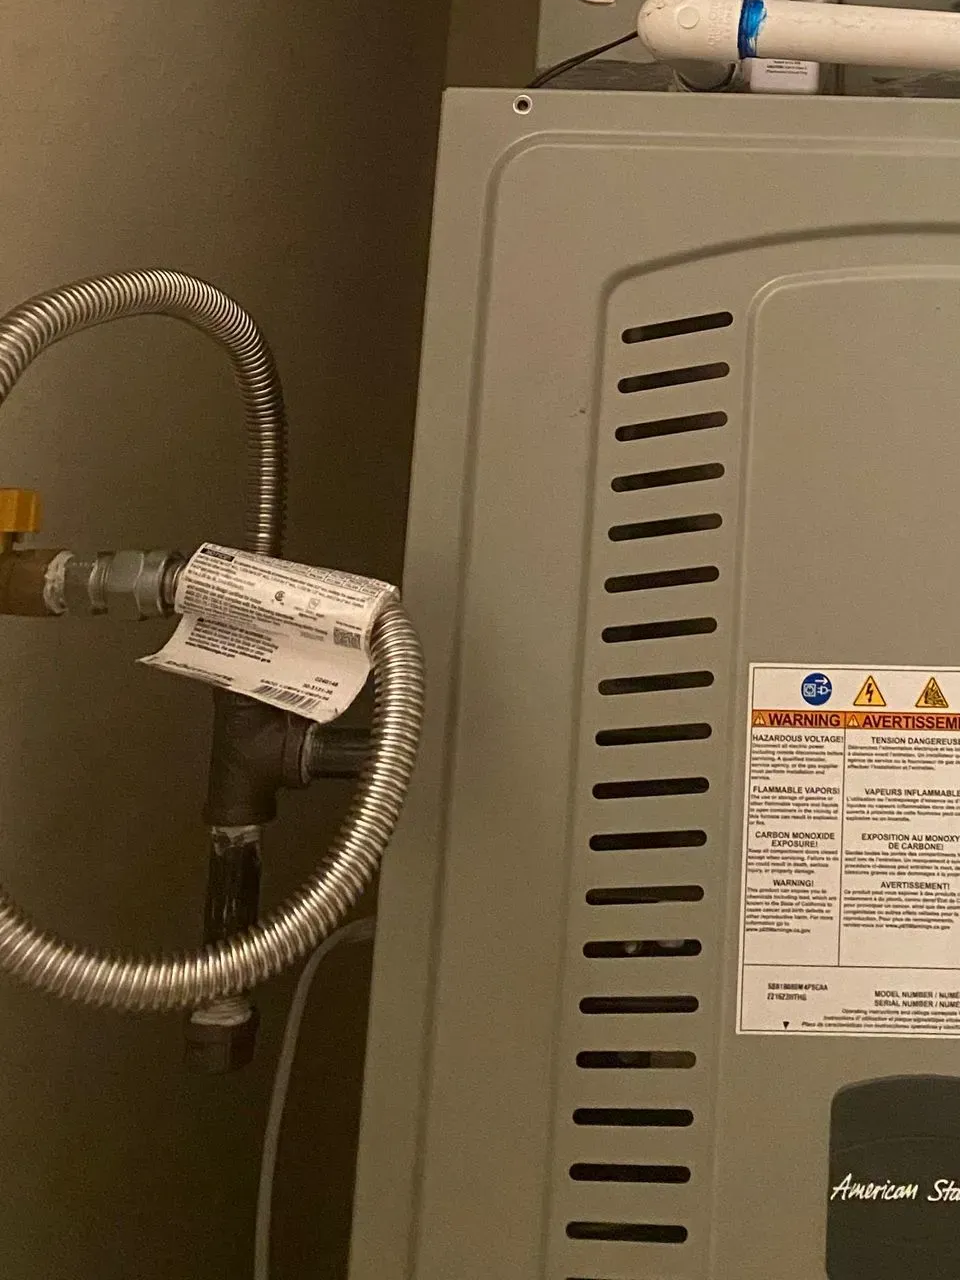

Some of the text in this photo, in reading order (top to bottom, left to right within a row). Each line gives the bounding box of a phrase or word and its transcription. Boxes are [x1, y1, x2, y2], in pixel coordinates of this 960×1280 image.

[768, 713, 841, 727] WARNING
[752, 734, 843, 743] HAZARDOUS VOLTAGE!
[865, 788, 902, 796] VAPEURS
[755, 831, 835, 840] CARBON MONOXIDE
[862, 833, 910, 841] EXPOSITION
[773, 879, 814, 887] WARNING!
[880, 881, 950, 890] AVERTISSEMENT!
[874, 990, 899, 998] MODEL
[874, 999, 899, 1007] SERIAL
[902, 1000, 933, 1008] NUMBER
[830, 1173, 918, 1201] American
